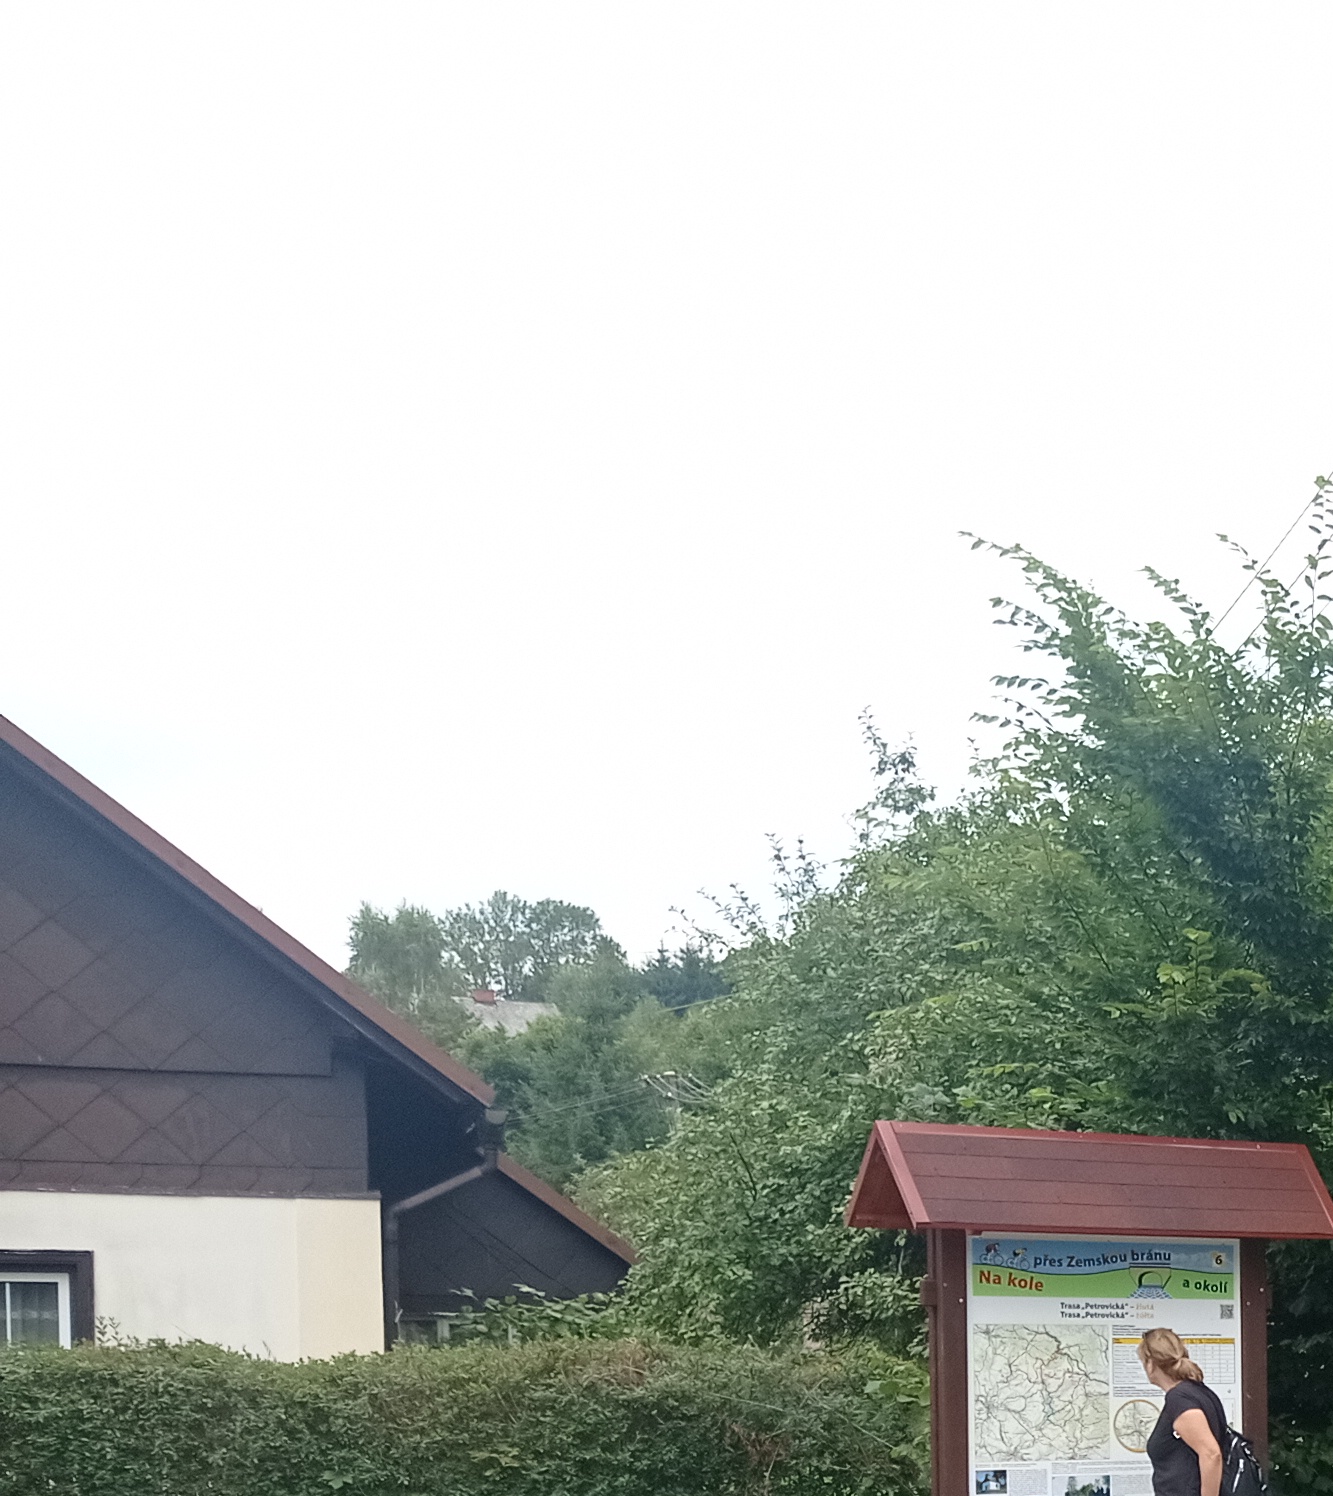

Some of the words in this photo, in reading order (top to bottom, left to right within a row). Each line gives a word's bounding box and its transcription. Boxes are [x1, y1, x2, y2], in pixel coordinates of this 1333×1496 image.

[1033, 1254, 1063, 1269] přes
[1066, 1253, 1127, 1268] Zemskou
[1131, 1249, 1171, 1261] bránu
[1215, 1255, 1223, 1265] 6
[979, 1270, 1002, 1285] Na
[1007, 1272, 1044, 1292] kole
[1182, 1279, 1190, 1288] a
[1194, 1280, 1228, 1294] okolí
[1060, 1302, 1081, 1310] Trasa
[1060, 1311, 1081, 1319] Trasa
